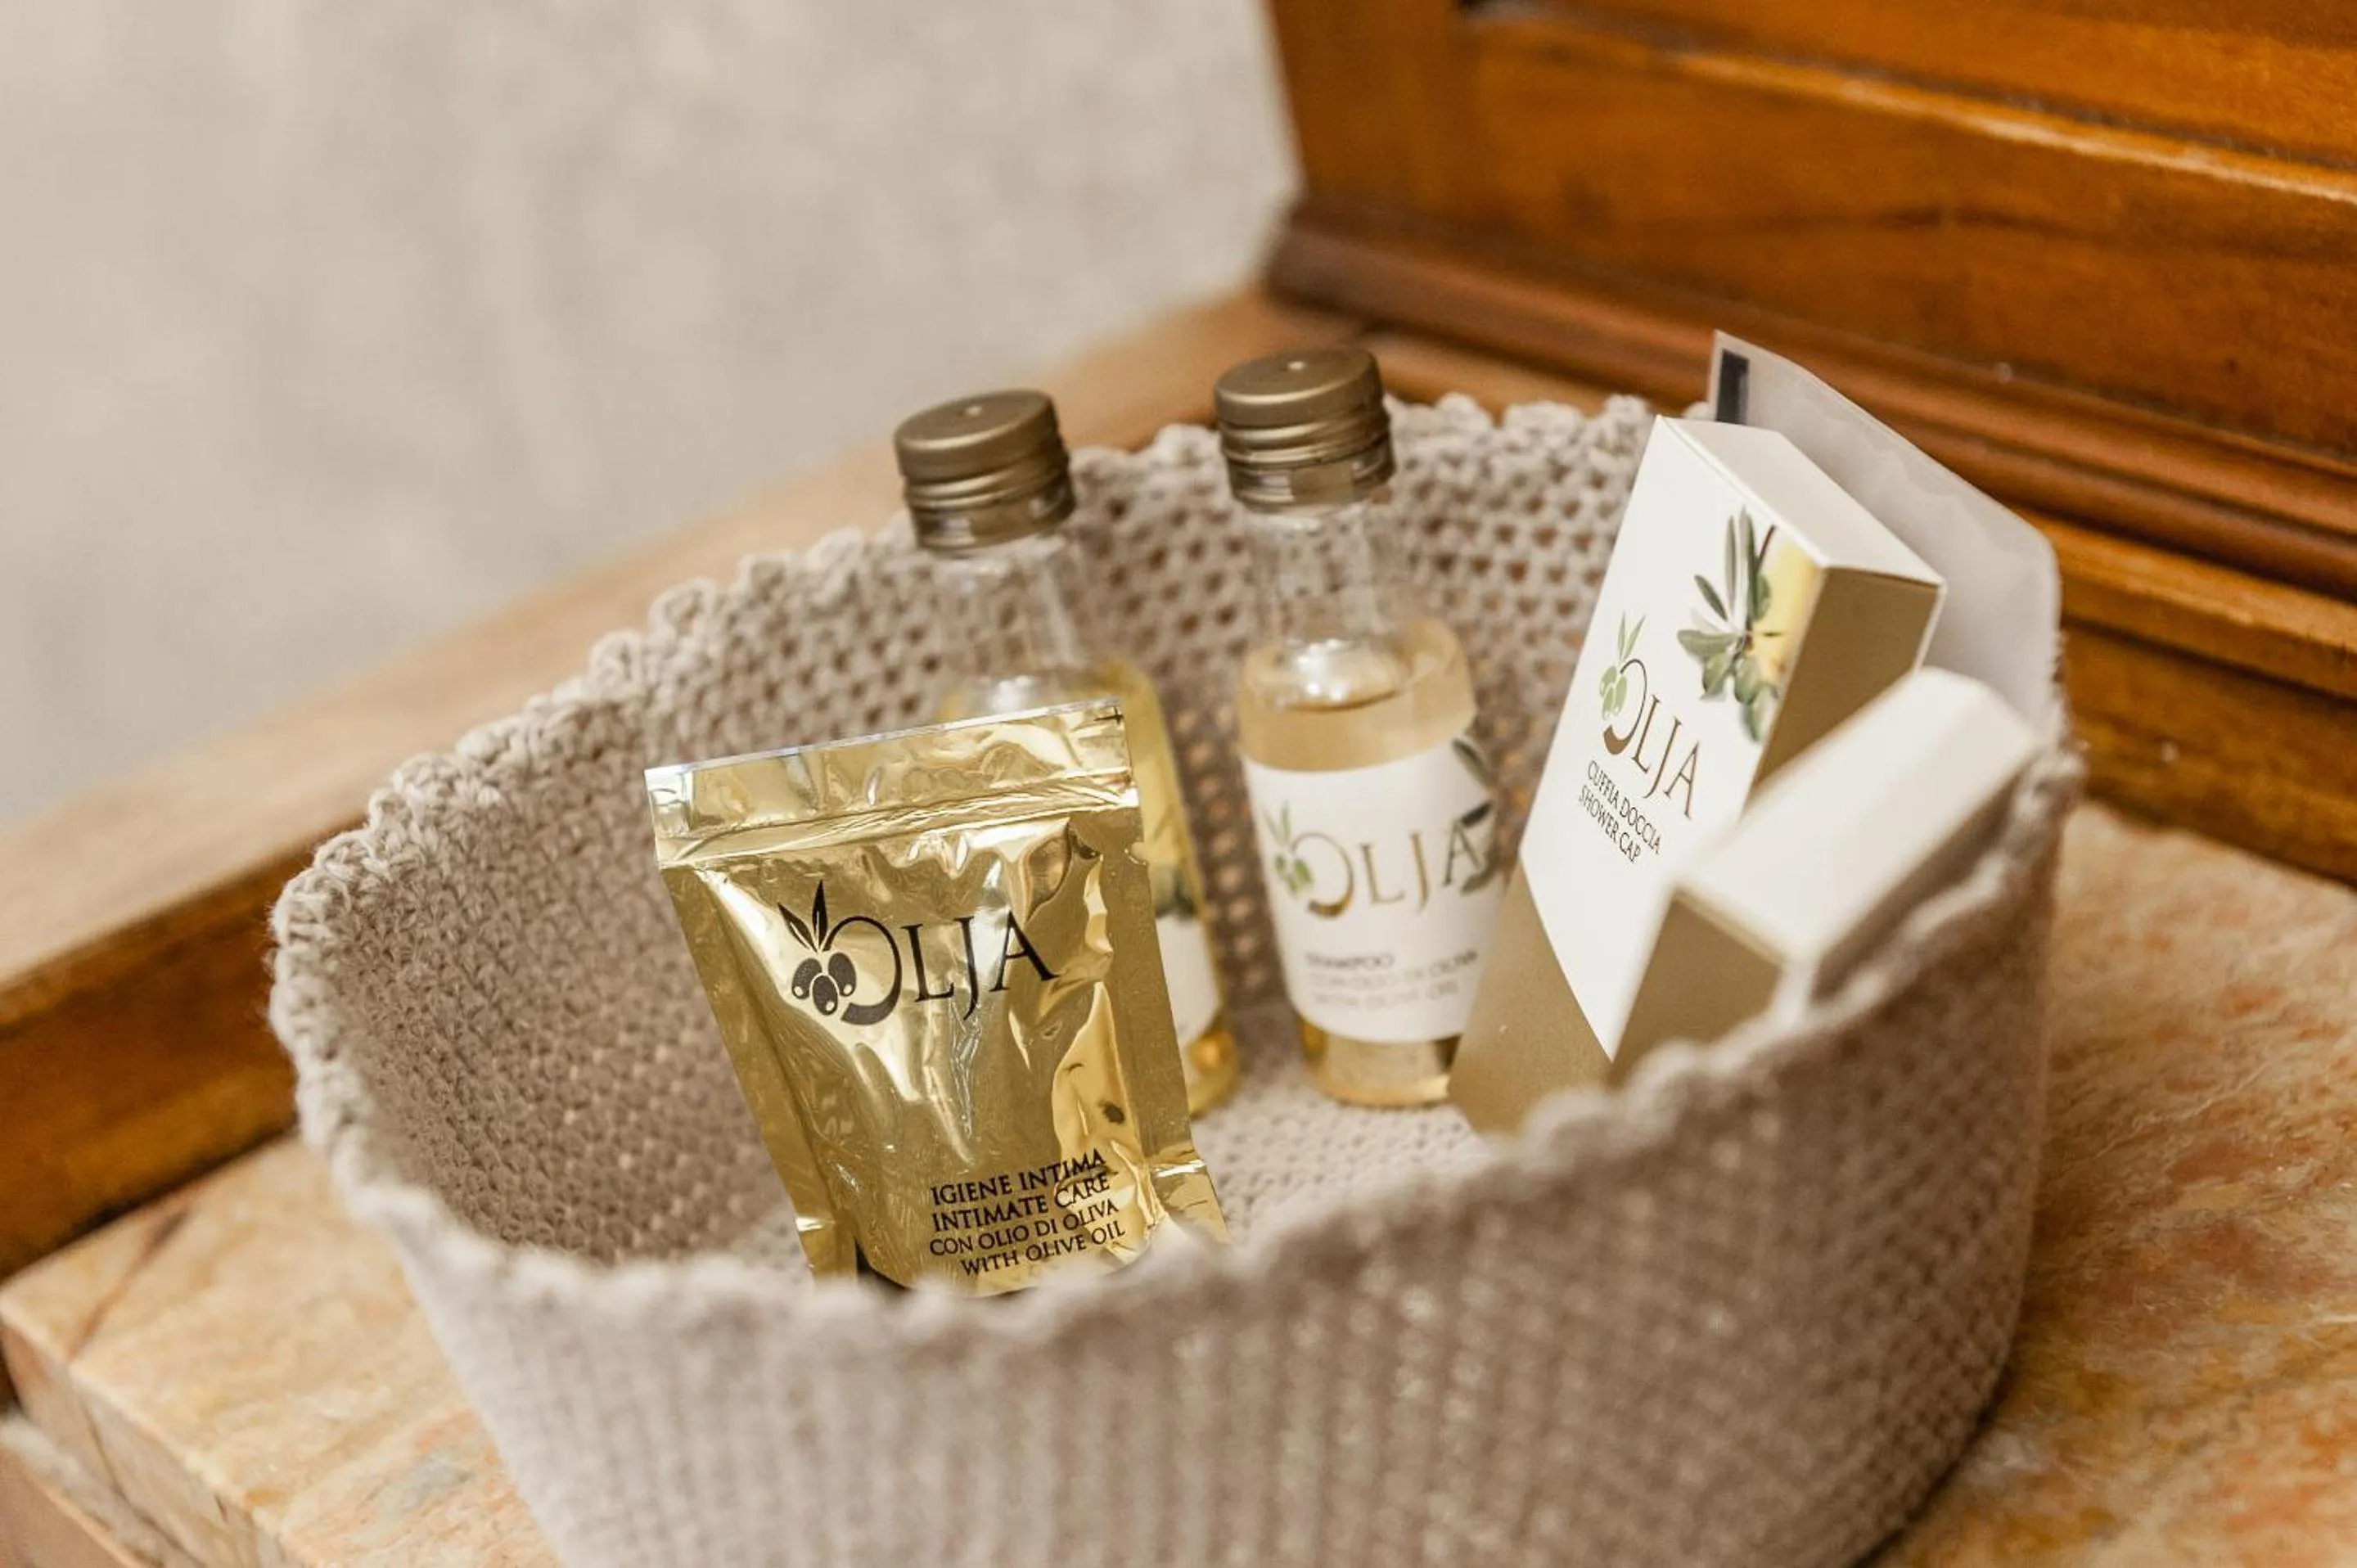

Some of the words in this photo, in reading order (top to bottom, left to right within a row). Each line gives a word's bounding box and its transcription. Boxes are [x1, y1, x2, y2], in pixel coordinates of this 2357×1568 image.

[1602, 659, 1699, 819] OLJA
[1579, 785, 1620, 842] SHOWER
[1620, 831, 1641, 862] CAP
[1588, 760, 1619, 809] CUFFIA
[1620, 797, 1661, 854] DOCCIA
[1289, 818, 1485, 920] OLJA
[822, 910, 1061, 1026] OLJA
[931, 1174, 1012, 1205] IGIENE
[1018, 1148, 1106, 1191] INTIMA
[932, 1195, 1049, 1232] INTIMATE
[1054, 1171, 1110, 1209] CARE
[930, 1237, 974, 1256] CON
[978, 1224, 1030, 1250] OLIO
[1035, 1219, 1058, 1238] DI
[1063, 1198, 1120, 1232] OLIVA
[960, 1250, 1021, 1277] WITH
[1025, 1233, 1087, 1262] OLIVE
[1092, 1219, 1127, 1246] OIL
